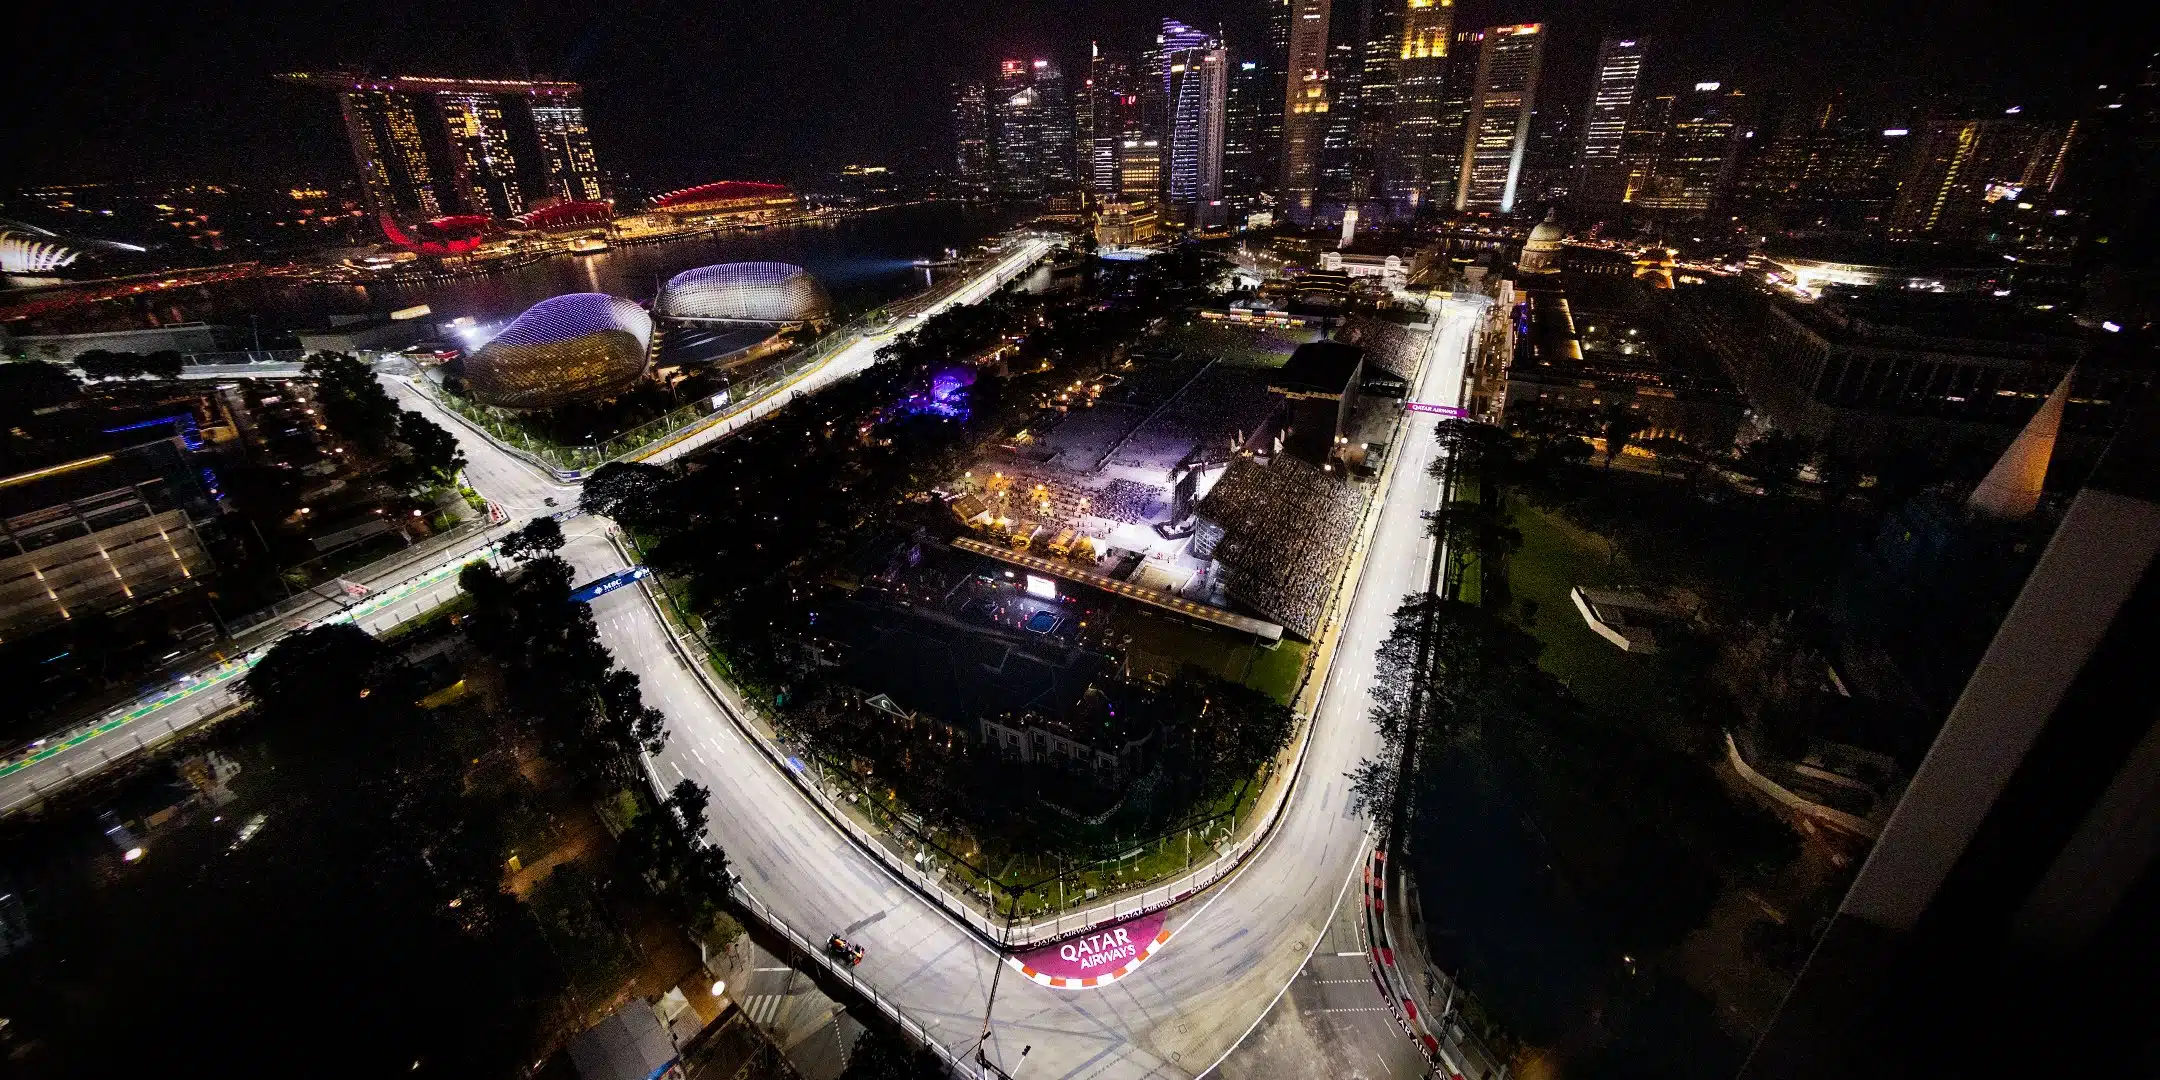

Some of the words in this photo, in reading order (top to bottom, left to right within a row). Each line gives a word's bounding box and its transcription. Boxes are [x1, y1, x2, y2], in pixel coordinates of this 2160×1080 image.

[1117, 909, 1143, 922] QATAR
[1144, 897, 1177, 913] AIRWAYS
[1033, 934, 1061, 948] QATAR
[1063, 923, 1097, 940] AIRWAYS
[1080, 944, 1136, 970] AIRWAYS
